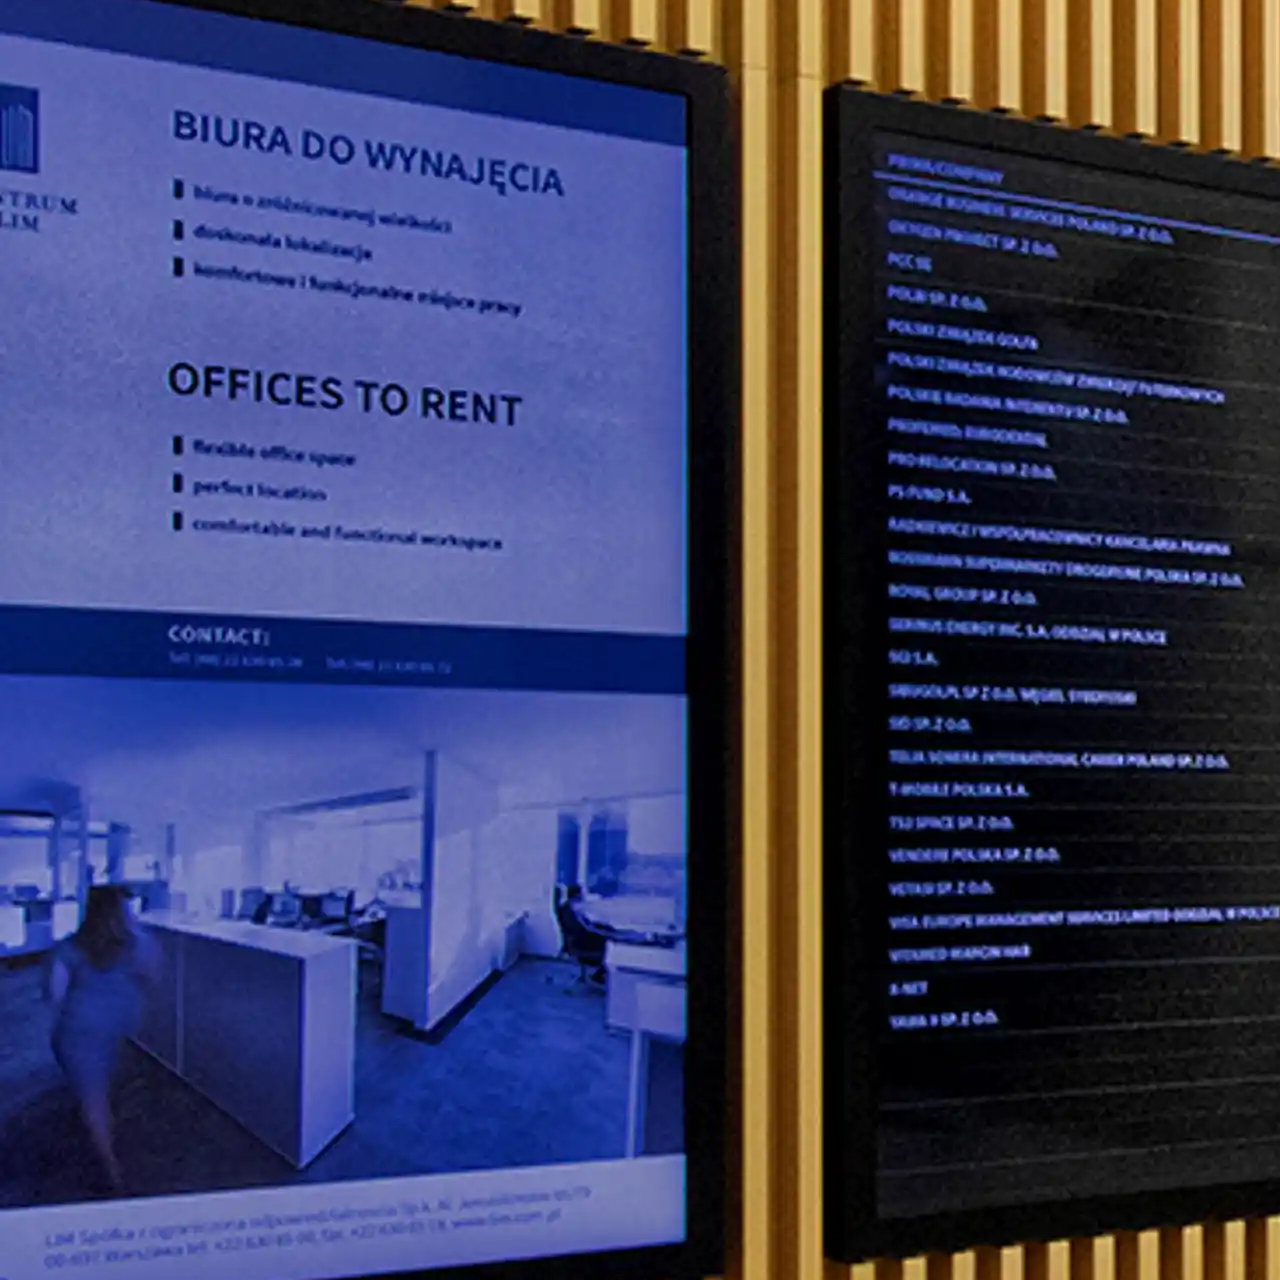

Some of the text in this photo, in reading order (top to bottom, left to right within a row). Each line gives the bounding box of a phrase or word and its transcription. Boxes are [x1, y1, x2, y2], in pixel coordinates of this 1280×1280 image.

[173, 109, 565, 198] BIURA DO WYNAJĘCIA
[0, 191, 79, 216] TRUM
[168, 362, 524, 427] OFFICES TO RENT
[260, 444, 305, 463] office
[308, 449, 356, 468] space
[257, 484, 328, 502] location
[193, 518, 297, 537] comfortable
[300, 524, 331, 540] and
[334, 525, 417, 545] functional
